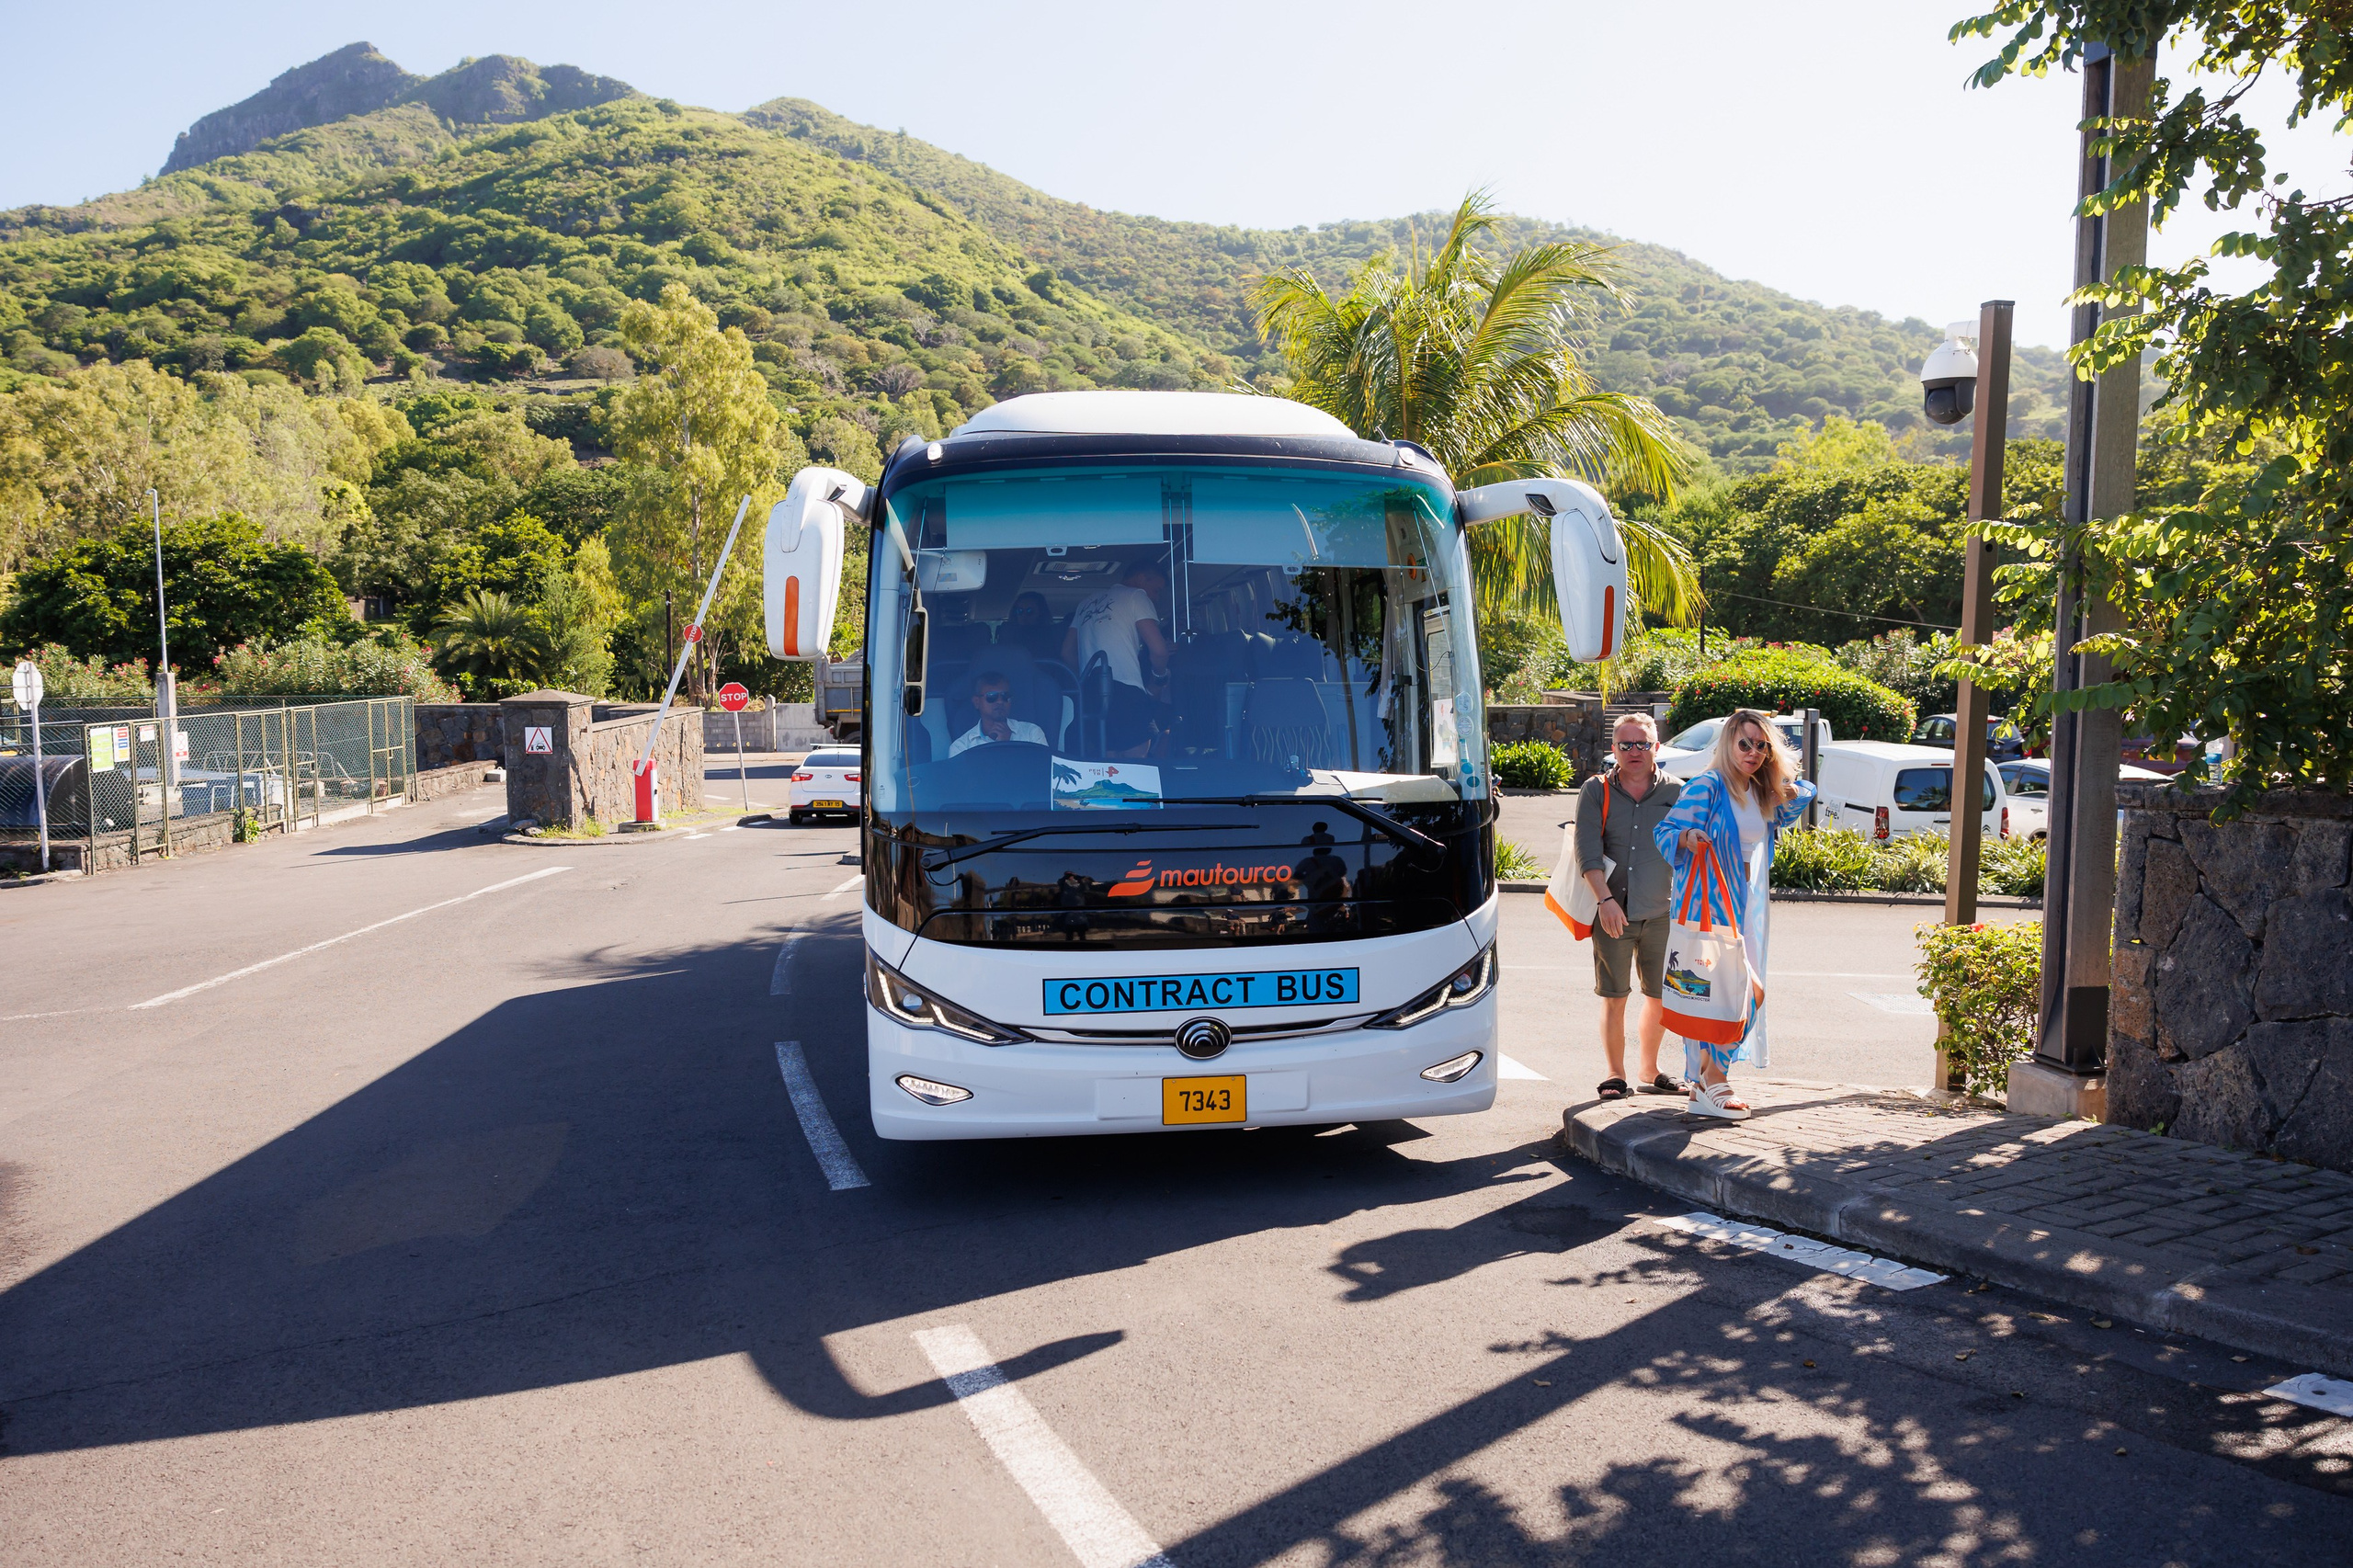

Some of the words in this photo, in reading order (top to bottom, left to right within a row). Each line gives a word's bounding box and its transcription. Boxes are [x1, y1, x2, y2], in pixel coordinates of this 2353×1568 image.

[688, 625, 699, 642] STOP
[721, 692, 747, 702] STOP
[1159, 862, 1292, 887] mautourco
[1060, 976, 1256, 1010] CONTRACT
[1278, 972, 1345, 1002] BUS
[1179, 1089, 1232, 1112] 7343
